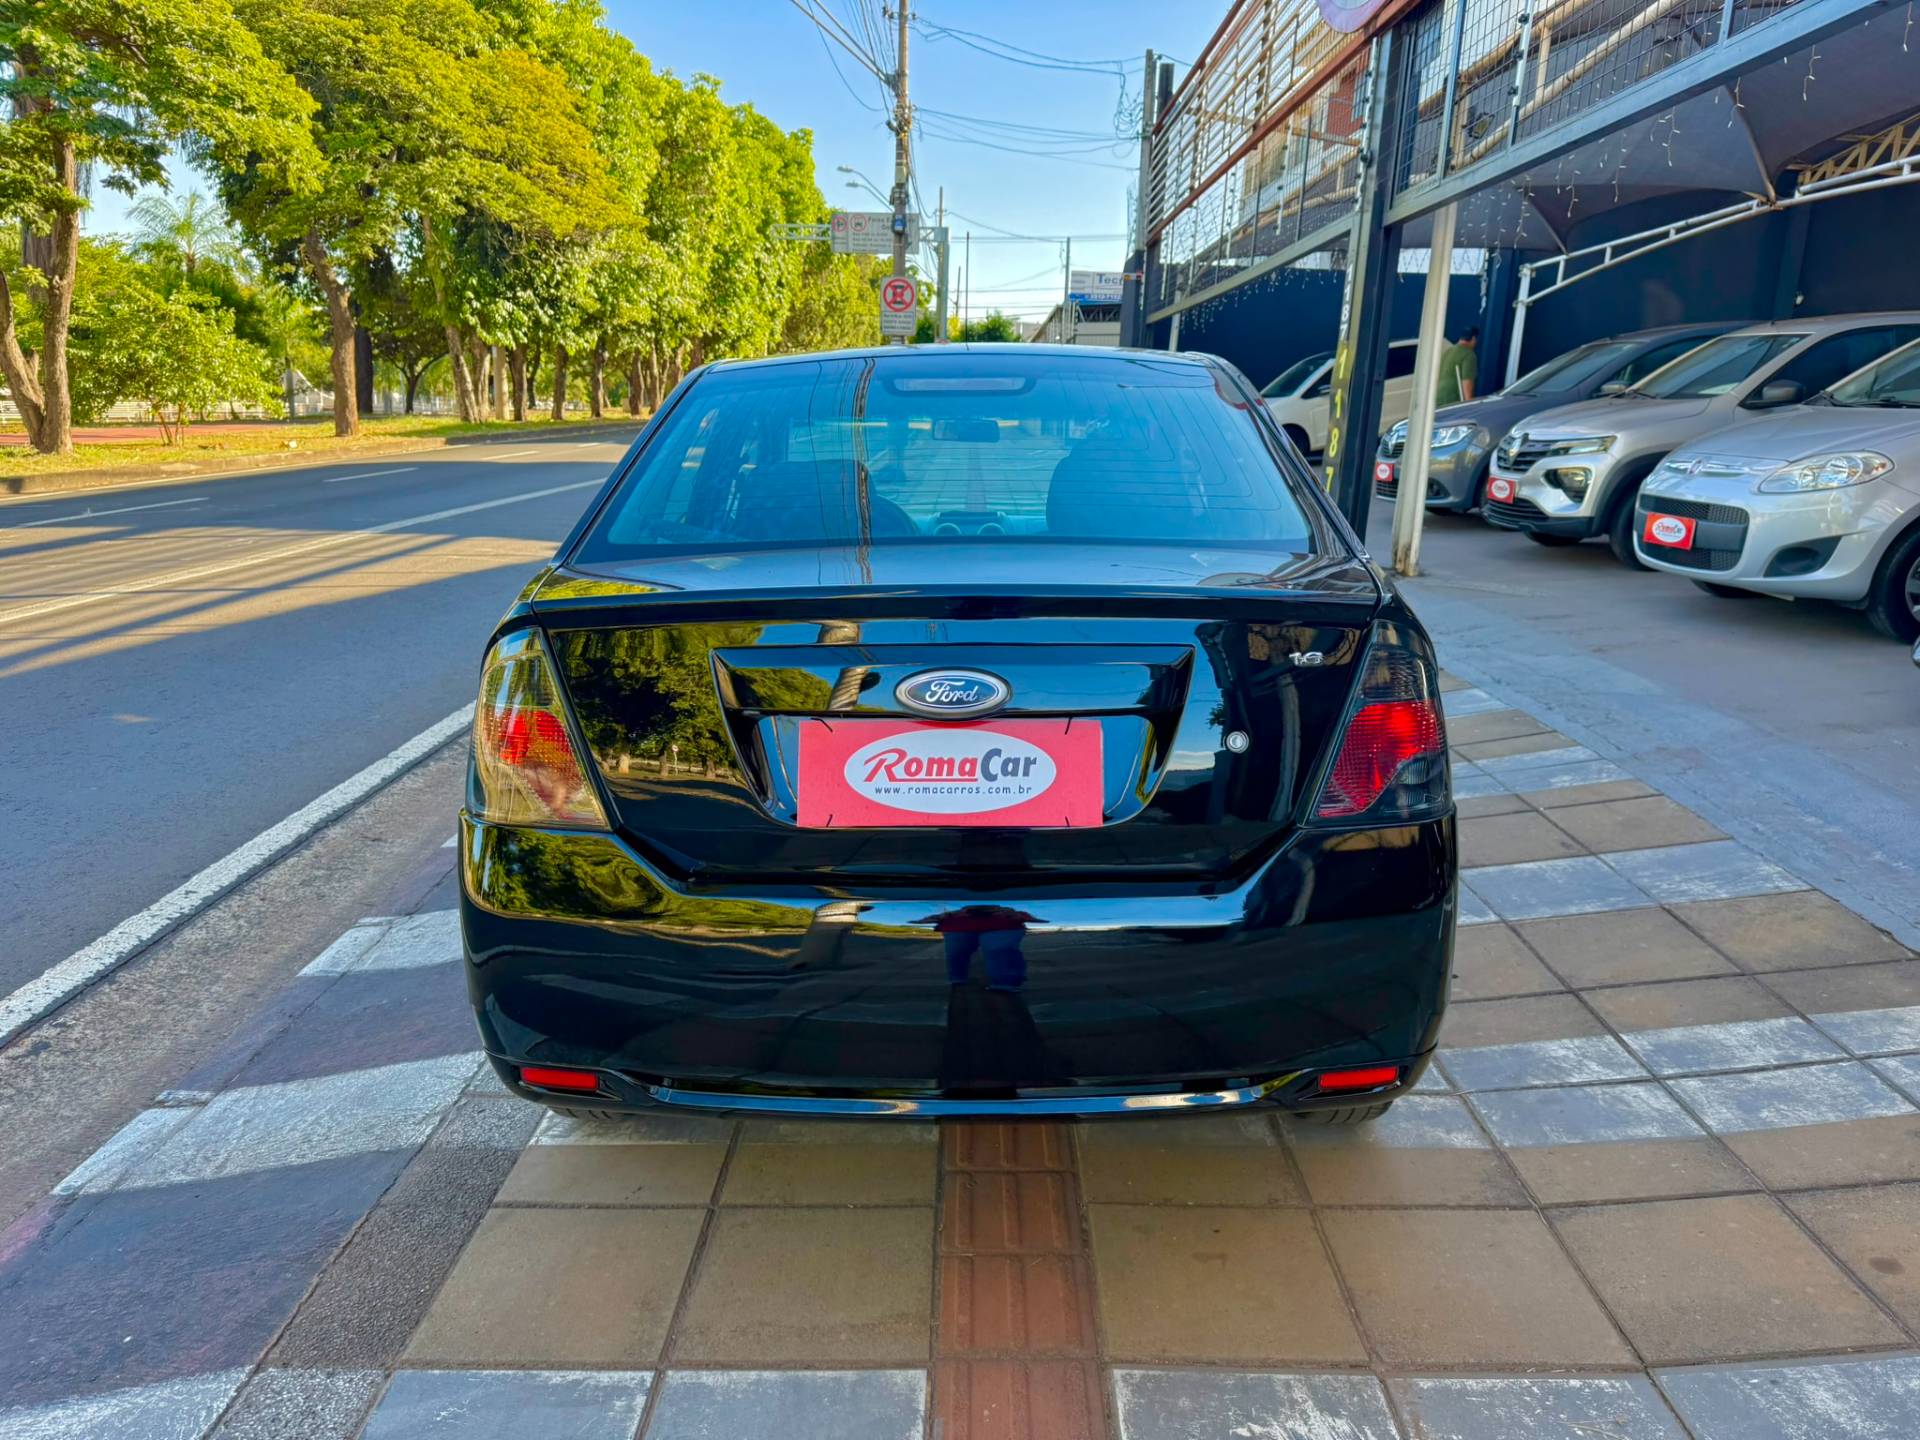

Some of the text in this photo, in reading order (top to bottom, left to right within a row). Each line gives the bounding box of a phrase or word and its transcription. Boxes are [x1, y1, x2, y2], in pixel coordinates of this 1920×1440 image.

[926, 680, 979, 702] Ford
[863, 747, 1037, 783] RomaCar
[874, 784, 1033, 795] www.romacarros.com.br
